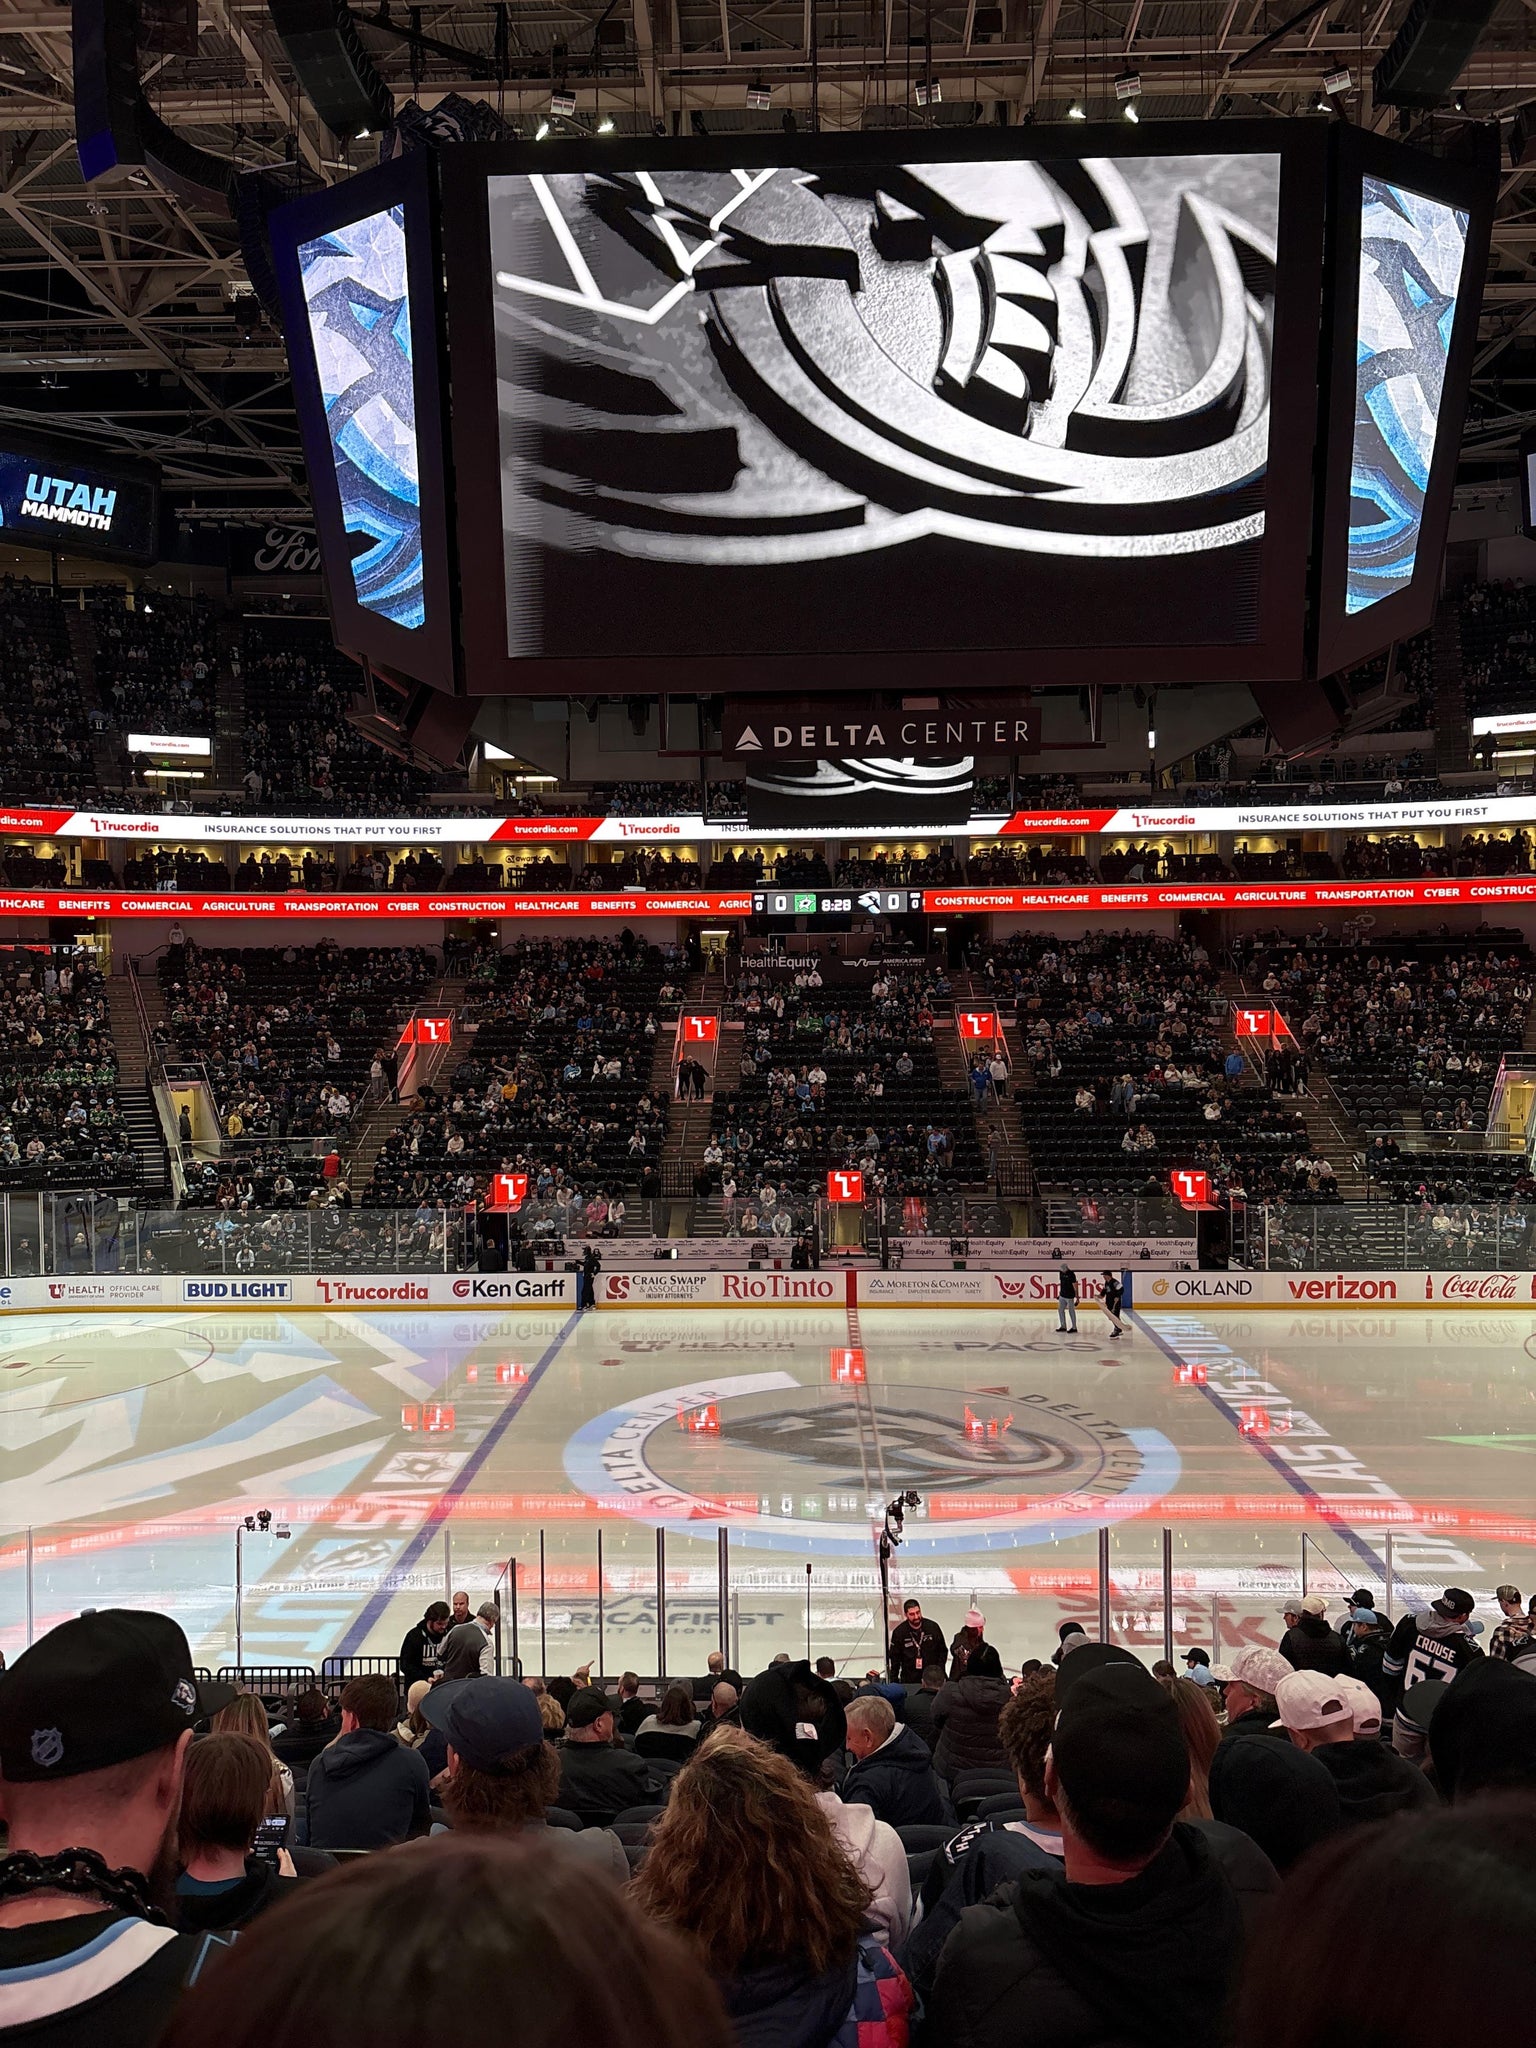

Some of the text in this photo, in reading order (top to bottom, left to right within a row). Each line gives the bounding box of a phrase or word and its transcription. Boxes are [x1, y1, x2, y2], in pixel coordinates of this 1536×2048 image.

[25, 473, 117, 516] UTAH
[21, 500, 112, 531] MAMMOTH
[254, 527, 321, 571] For
[773, 721, 1029, 748] DELTA CENTER
[1024, 817, 1090, 826] trucordia.com
[1142, 815, 1196, 826] Trucordia
[1238, 806, 1489, 823] INSURANCE SOLUTIONS THAT PUT YOU FIRST
[101, 819, 159, 832] Trucordia
[204, 824, 442, 835] INSURANCE SOLUTIONS THAT PUT YOU FIRST
[514, 825, 579, 834] trucordia.com
[629, 823, 680, 834] Trucordia
[775, 896, 787, 911] 0
[888, 894, 900, 910] 0
[934, 895, 1013, 905] CONSTRUCTION
[1022, 894, 1090, 904] HEALTHCARE
[1101, 893, 1149, 903] BENEFITS
[1158, 892, 1226, 902] COMMERCIAL
[1234, 891, 1307, 901] AGRICULTURE
[1315, 889, 1414, 899] TRANSPORTATION
[1424, 887, 1460, 898] CYBER
[58, 900, 111, 910] BENEFITS
[121, 901, 193, 911] COMMERCIAL
[202, 902, 276, 911] AGRICULTURE
[284, 902, 379, 911] TRANSPORTATION
[387, 902, 420, 911] CYBER
[428, 902, 506, 911] CONSTRUCTION
[514, 901, 580, 910] HEALTHCARE
[590, 901, 637, 910] BENEFITS
[646, 900, 711, 909] COMMERCIAL
[821, 899, 852, 912] 8:28
[740, 956, 819, 970] HealthEquity
[632, 1274, 707, 1285] CRAIG SWAPP
[1030, 1275, 1105, 1299] Smth's
[1288, 1275, 1396, 1299] verizon
[68, 1285, 105, 1294] HEALTH
[187, 1283, 288, 1297] BUD LIGHT
[333, 1282, 428, 1300] Trucordia
[473, 1279, 565, 1297] Ken Garff
[647, 1285, 700, 1293] ASSOCIATES
[1175, 1280, 1252, 1296] OKLAND
[953, 1341, 1103, 1351] PACS
[610, 1390, 729, 1440] CENTER
[1018, 1394, 1131, 1441] DELTA
[1415, 1634, 1457, 1663] CROUSE
[1404, 1649, 1458, 1691] 67
